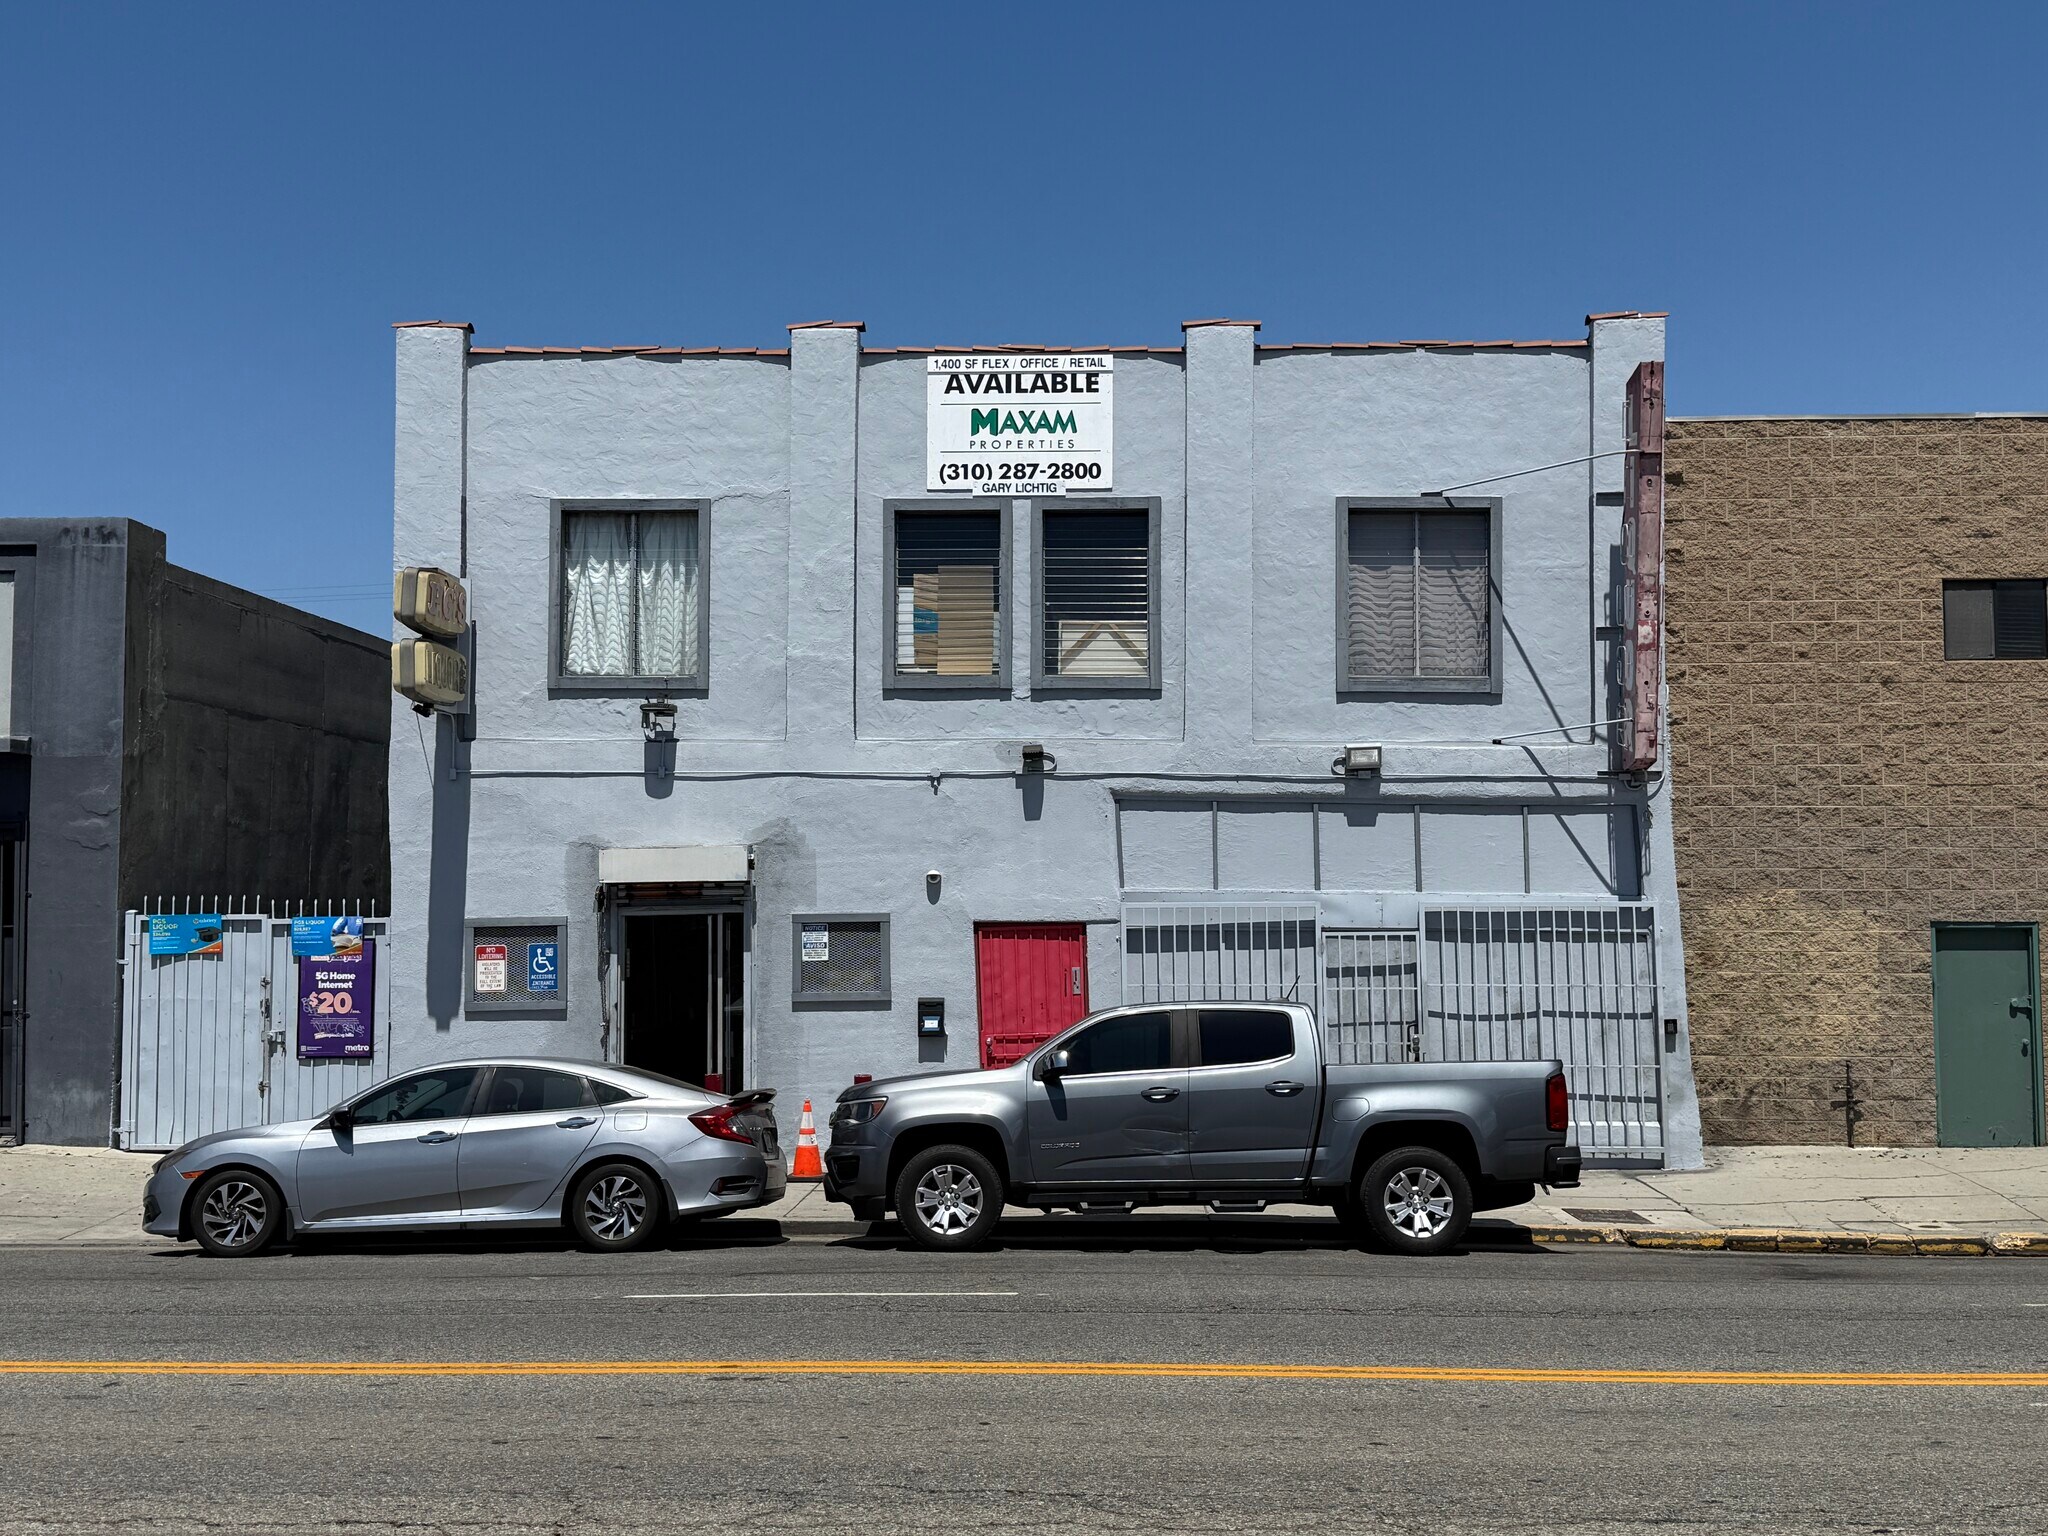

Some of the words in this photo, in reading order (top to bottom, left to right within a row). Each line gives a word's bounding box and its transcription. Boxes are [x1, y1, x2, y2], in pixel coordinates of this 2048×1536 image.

[934, 359, 961, 370] 1,400
[964, 359, 978, 369] SF
[982, 359, 1010, 368] FLEX
[1020, 358, 1059, 368] OFFICE
[1069, 357, 1106, 368] RETAIL
[944, 373, 1100, 394] AVAILABLE
[971, 408, 1077, 436] MAXAM
[969, 440, 1075, 449] PROPERTIES
[939, 463, 993, 484] (310)
[998, 463, 1102, 480] 287-2800
[982, 483, 1012, 493] GARY
[1015, 482, 1057, 493] LICHTIG
[315, 972, 328, 980] 5G
[329, 972, 356, 980] Home
[318, 981, 353, 989] Internet
[309, 991, 352, 1014] $20
